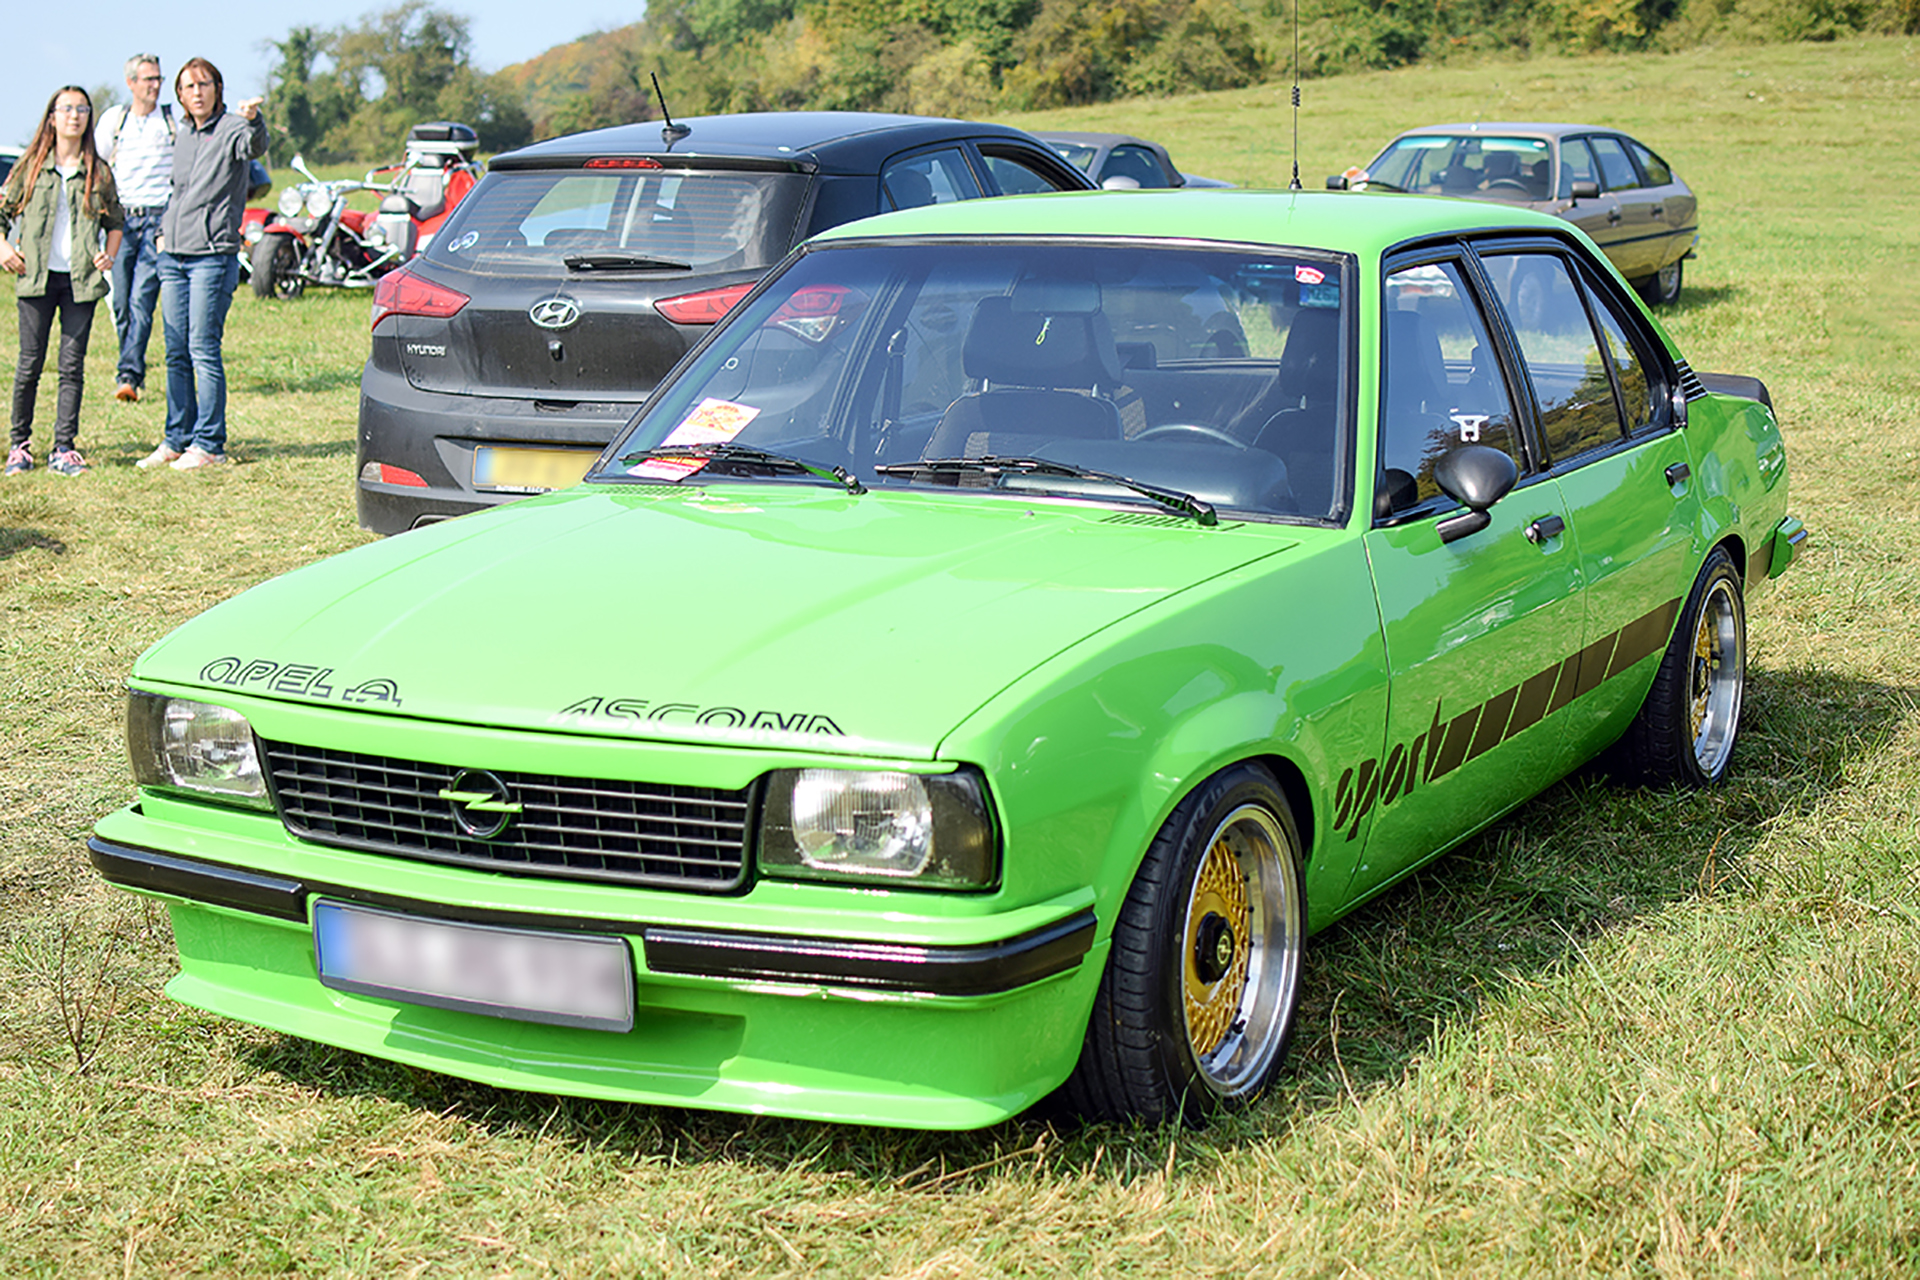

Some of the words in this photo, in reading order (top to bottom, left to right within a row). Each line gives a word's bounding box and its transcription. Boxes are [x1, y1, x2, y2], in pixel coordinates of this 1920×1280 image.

[406, 343, 447, 357] HYUNDAI
[199, 656, 334, 698] OPEL
[550, 696, 847, 737] ASCONA
[1333, 695, 1449, 843] sport
